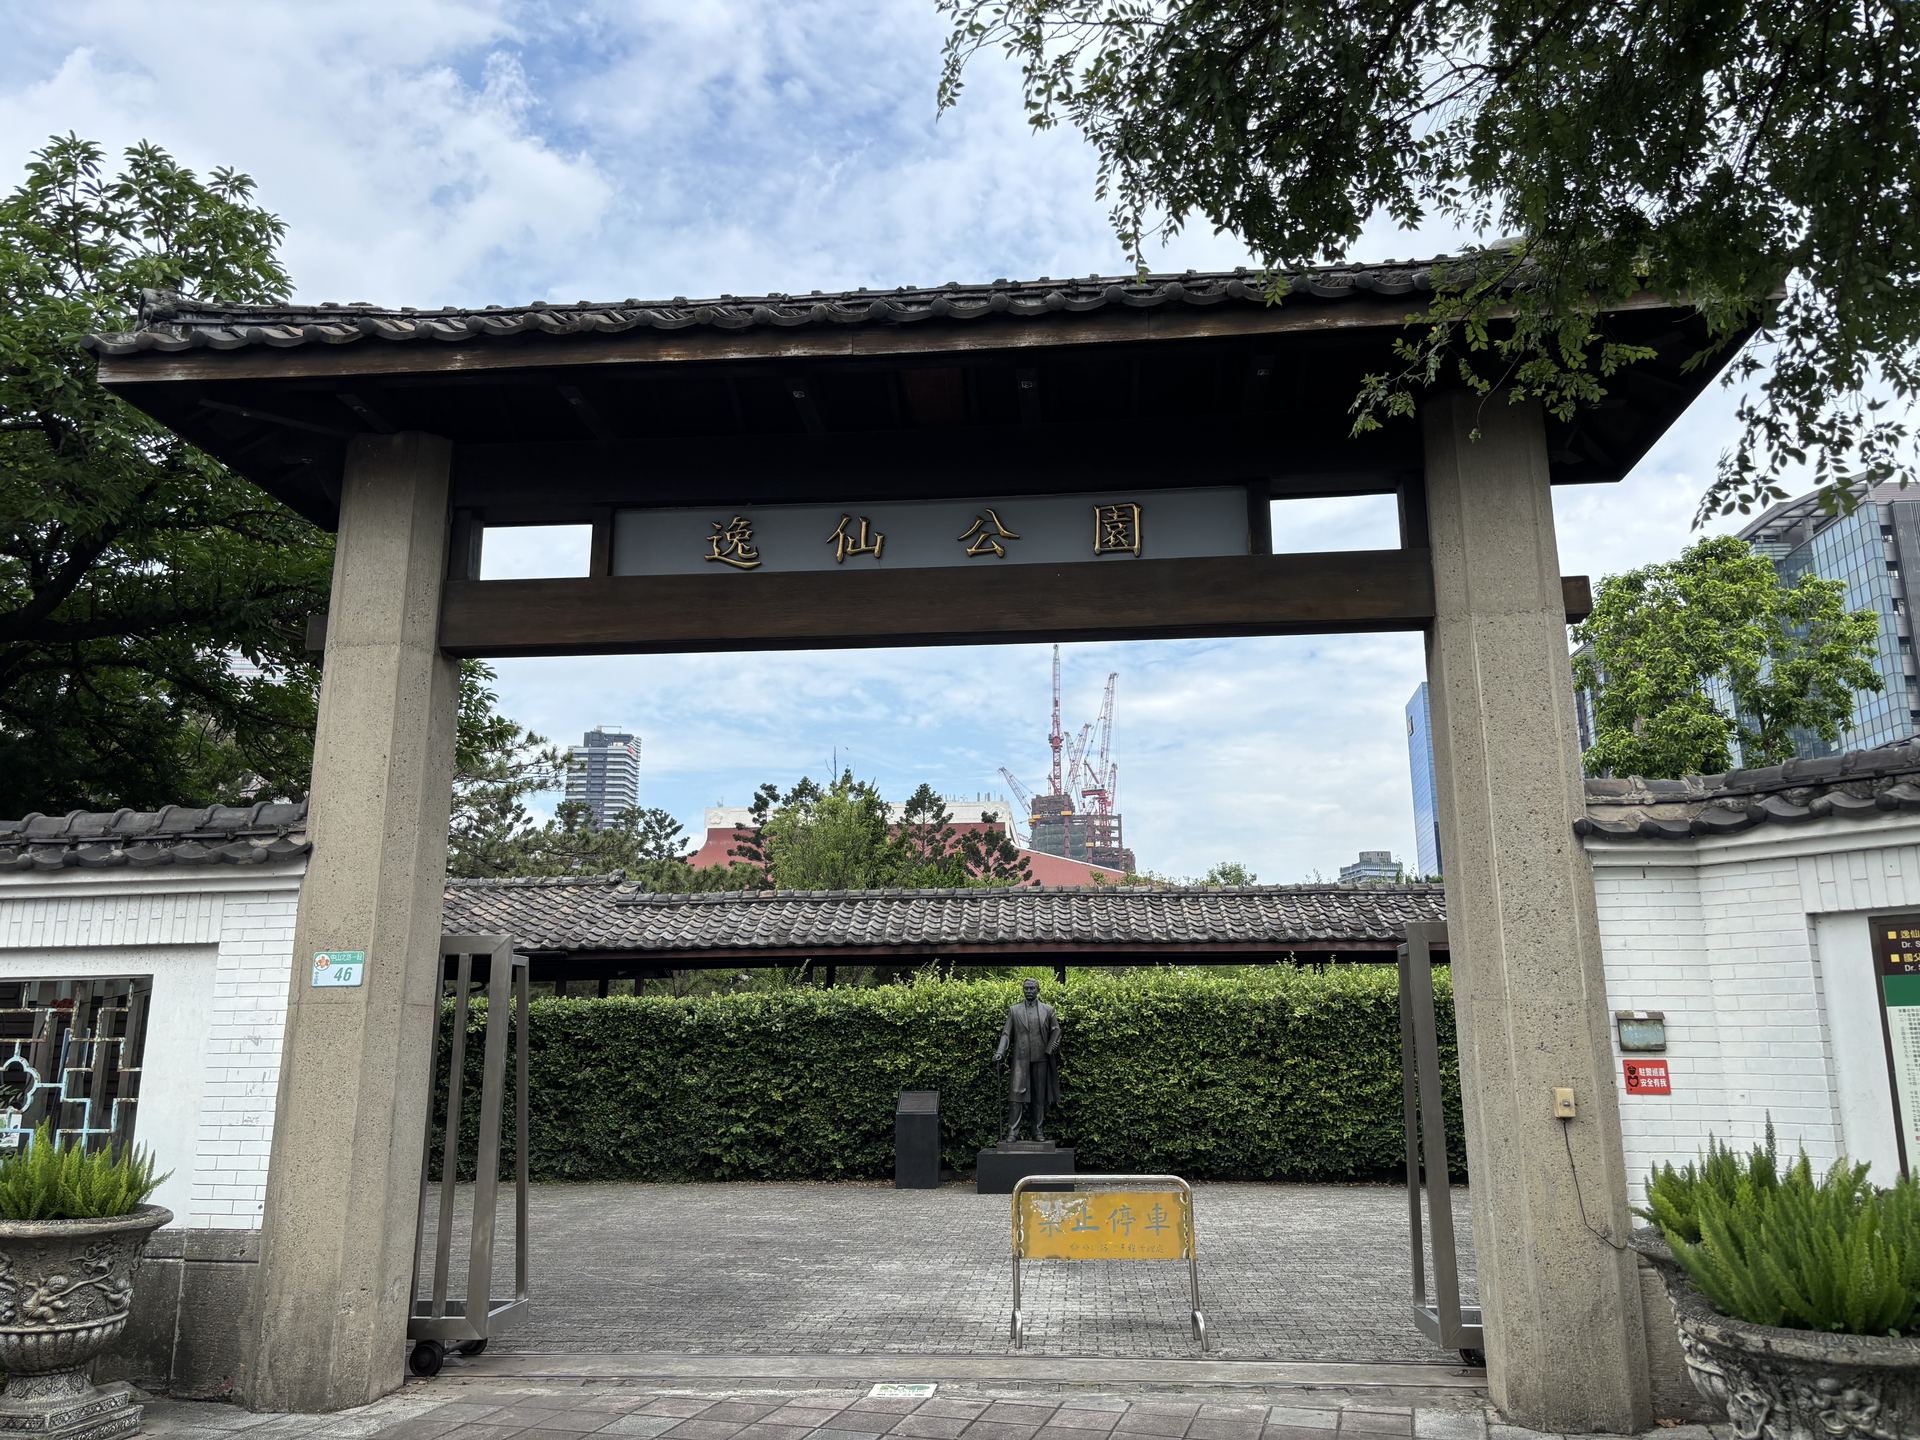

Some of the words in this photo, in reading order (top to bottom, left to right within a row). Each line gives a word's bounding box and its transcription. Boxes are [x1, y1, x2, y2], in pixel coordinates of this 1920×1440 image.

[703, 502, 1144, 571] 逸仙公園
[1901, 941, 1912, 949] Dr.
[334, 967, 353, 982] 46
[1640, 1078, 1667, 1088] 安全有我
